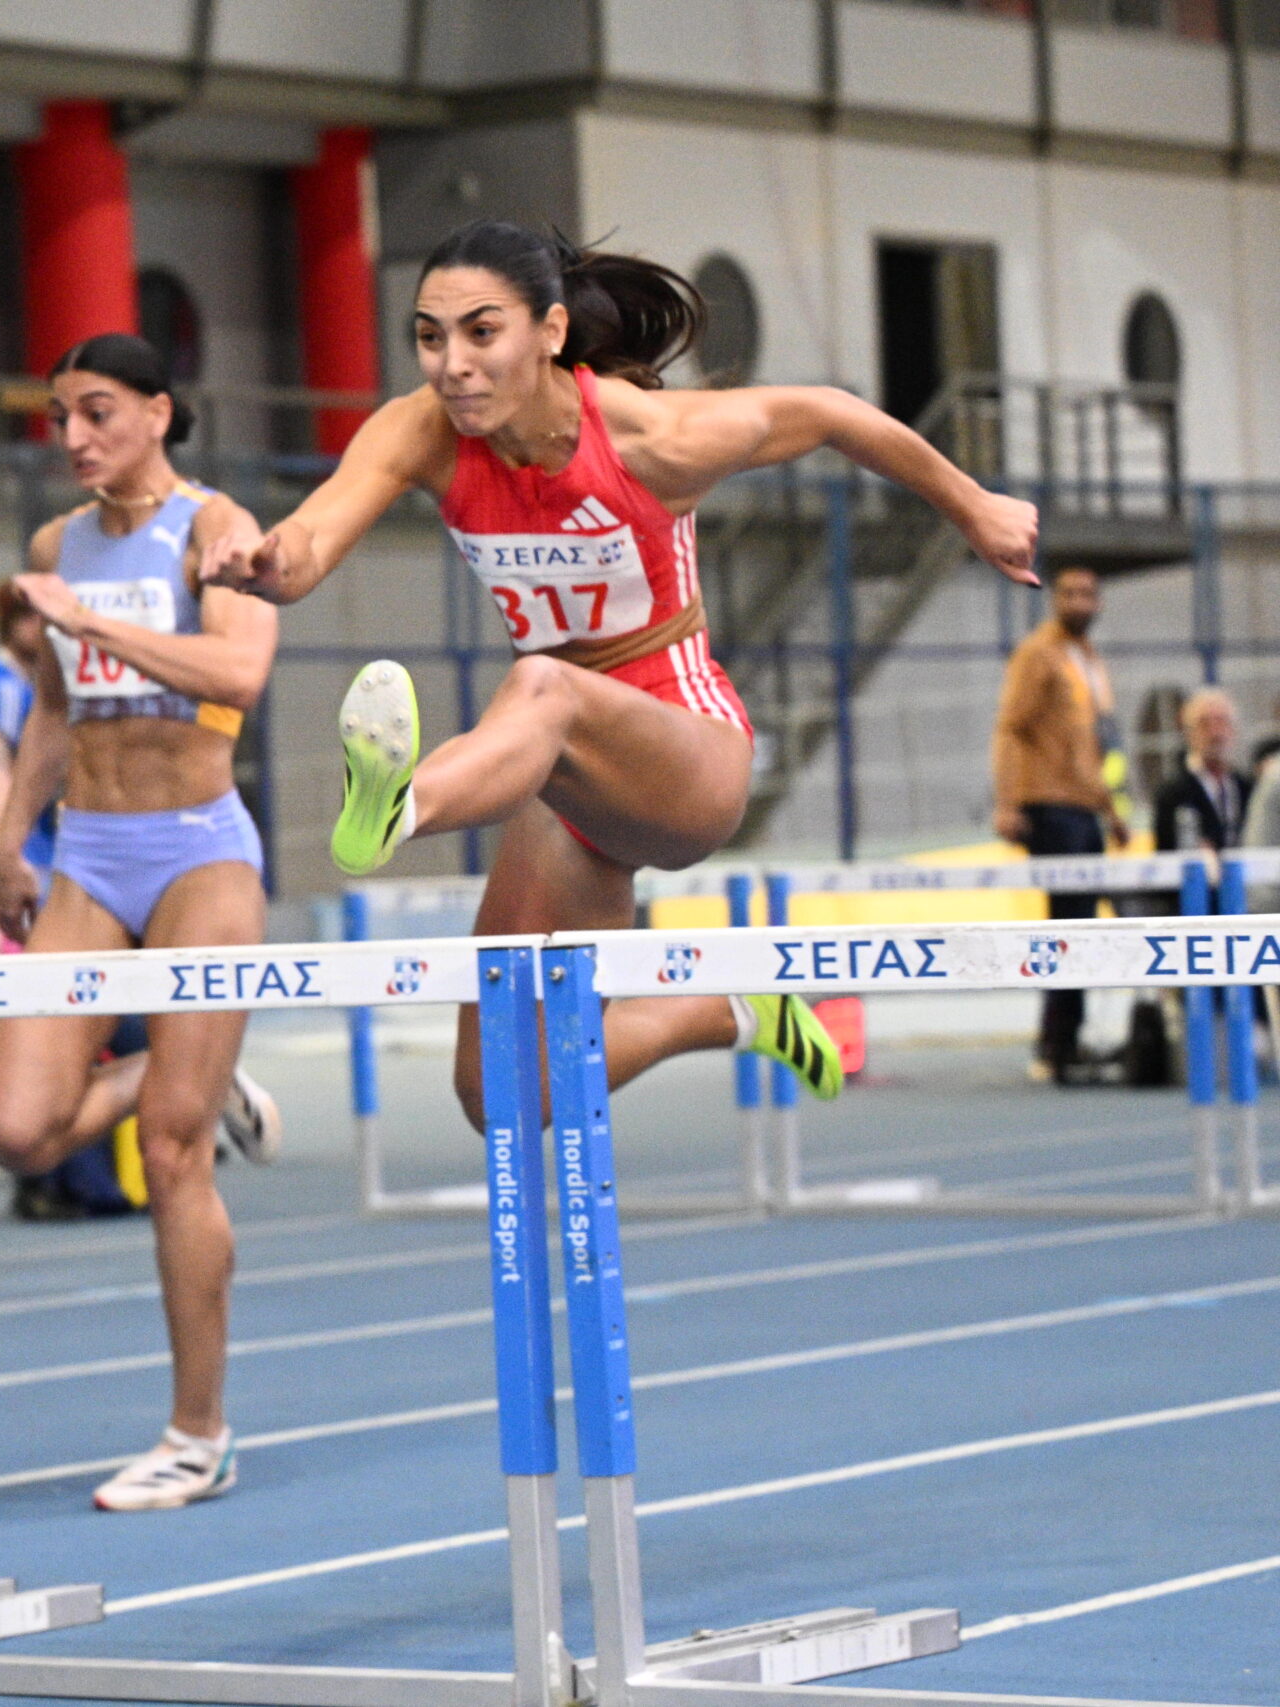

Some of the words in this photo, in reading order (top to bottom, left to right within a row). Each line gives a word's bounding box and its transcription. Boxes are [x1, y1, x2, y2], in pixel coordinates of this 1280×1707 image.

[494, 546, 587, 567] ΣΕΓΑΣ
[491, 582, 608, 640] 317
[772, 938, 948, 980] ΣΕΓΑΣ
[169, 960, 322, 1001] ΣΕΓΑΣ
